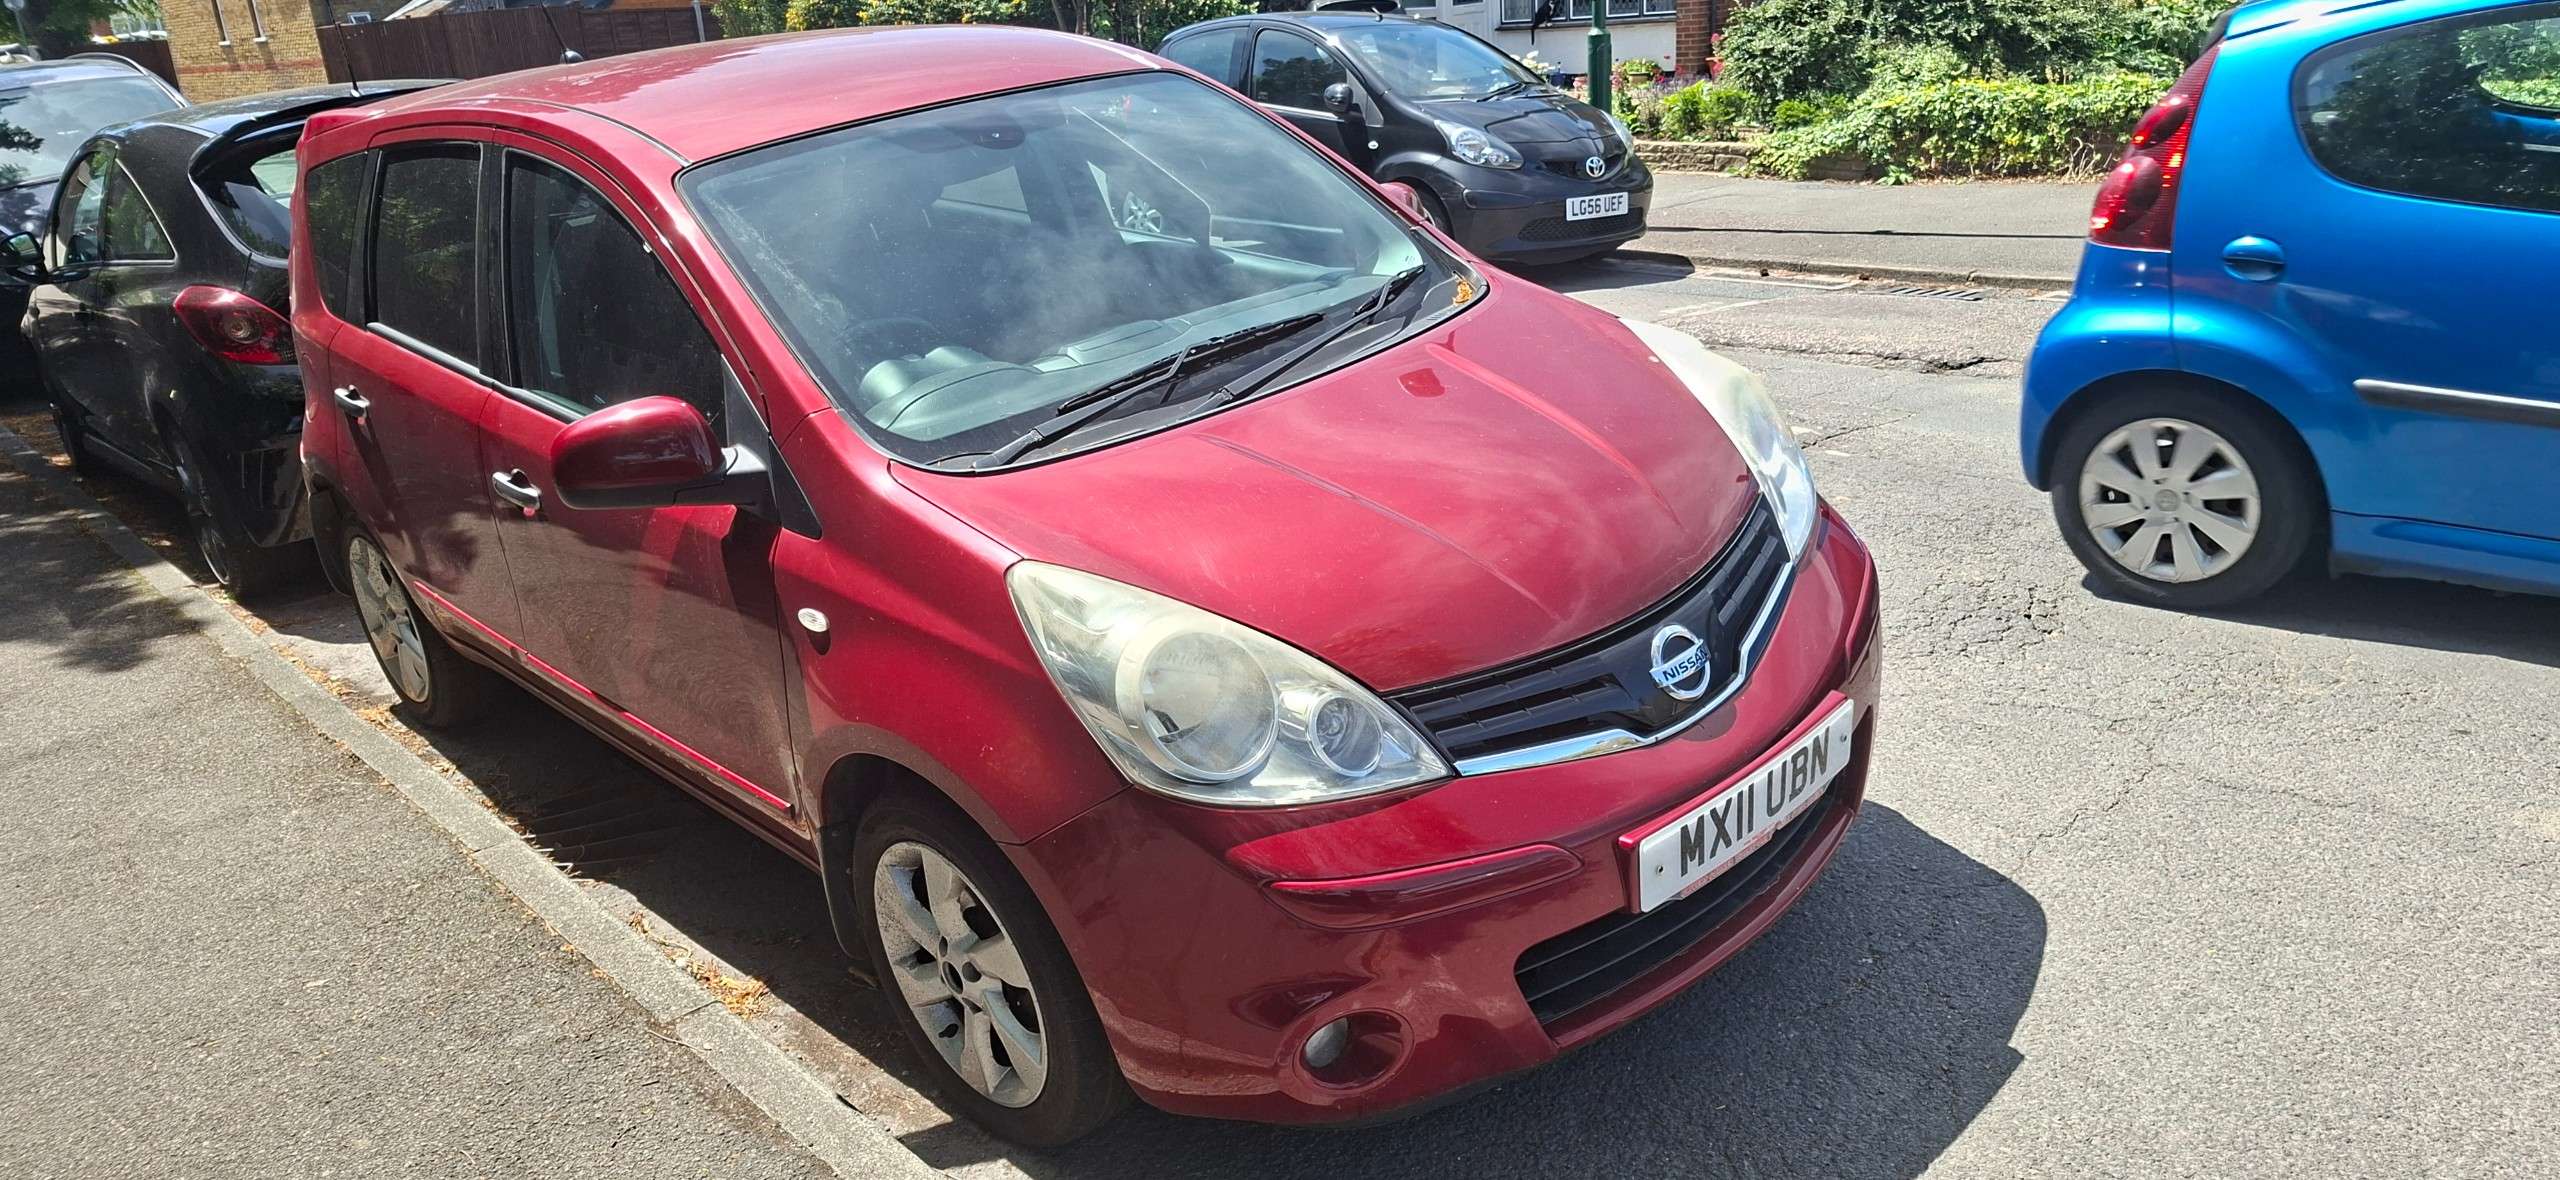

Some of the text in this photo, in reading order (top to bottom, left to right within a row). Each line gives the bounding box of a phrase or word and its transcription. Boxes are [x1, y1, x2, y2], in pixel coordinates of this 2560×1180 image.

[1572, 195, 1624, 217] LG56 UEF
[1662, 646, 1709, 681] NISSAN
[1680, 783, 1755, 878] MX11
[1766, 726, 1830, 817] UBN
